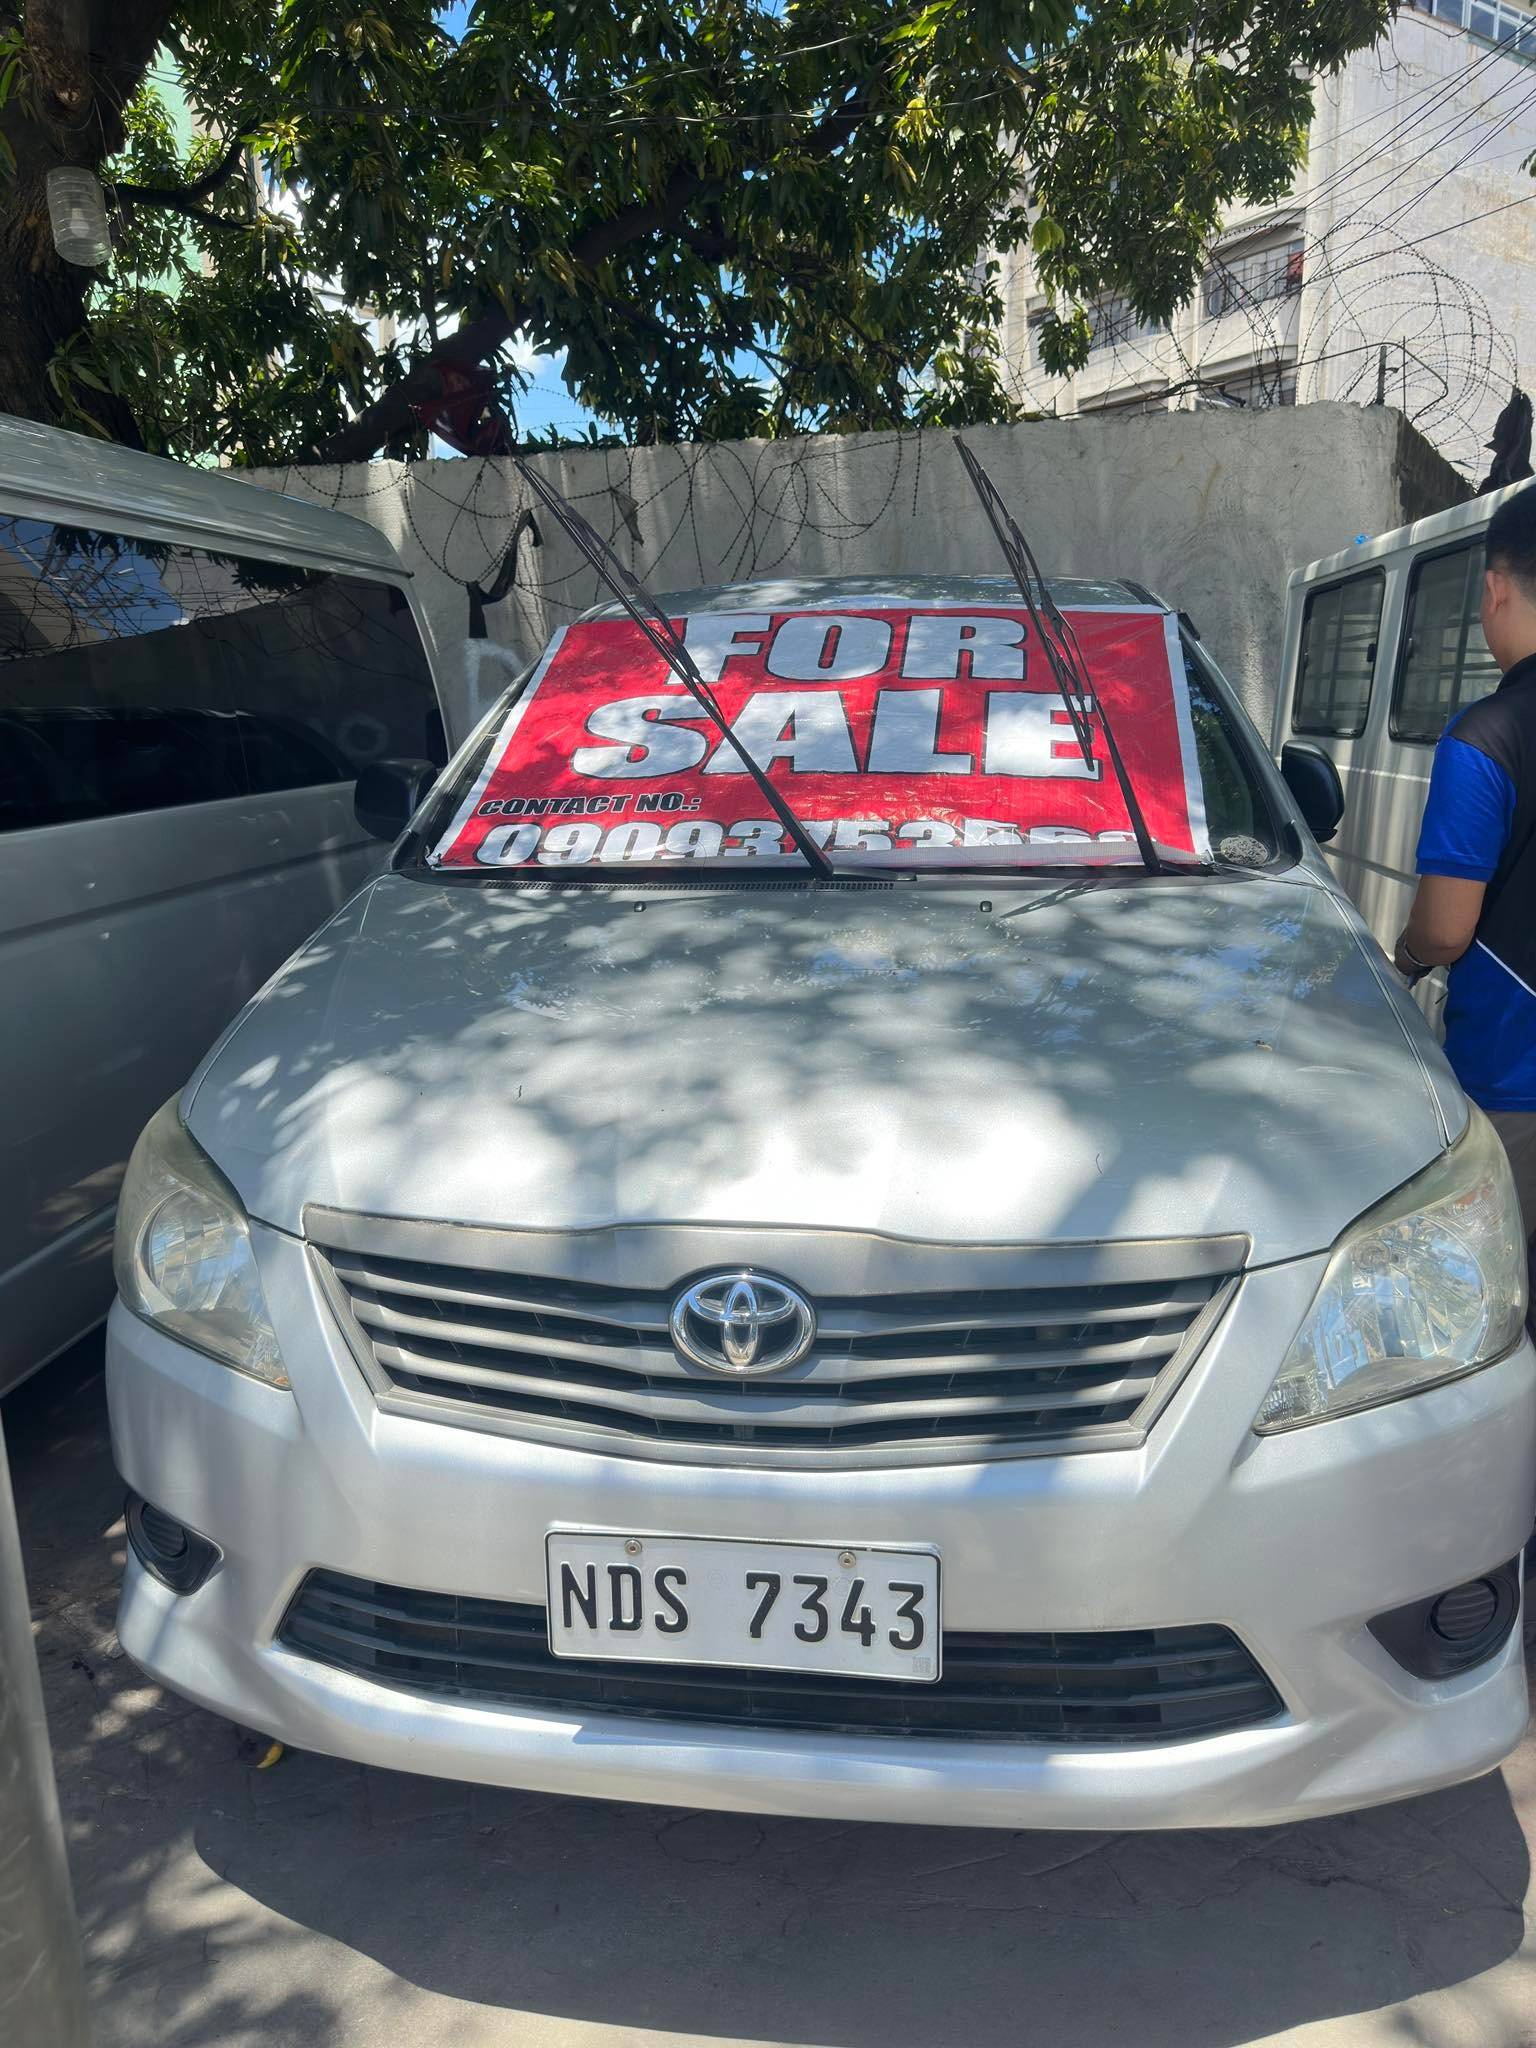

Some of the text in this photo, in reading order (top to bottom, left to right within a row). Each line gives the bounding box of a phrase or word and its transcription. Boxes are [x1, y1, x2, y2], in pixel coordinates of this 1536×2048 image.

[665, 615, 1027, 686] FOR
[571, 690, 1103, 781] SALE
[478, 792, 702, 817] CONTACT NO.:
[560, 1562, 925, 1650] NDS 7343
